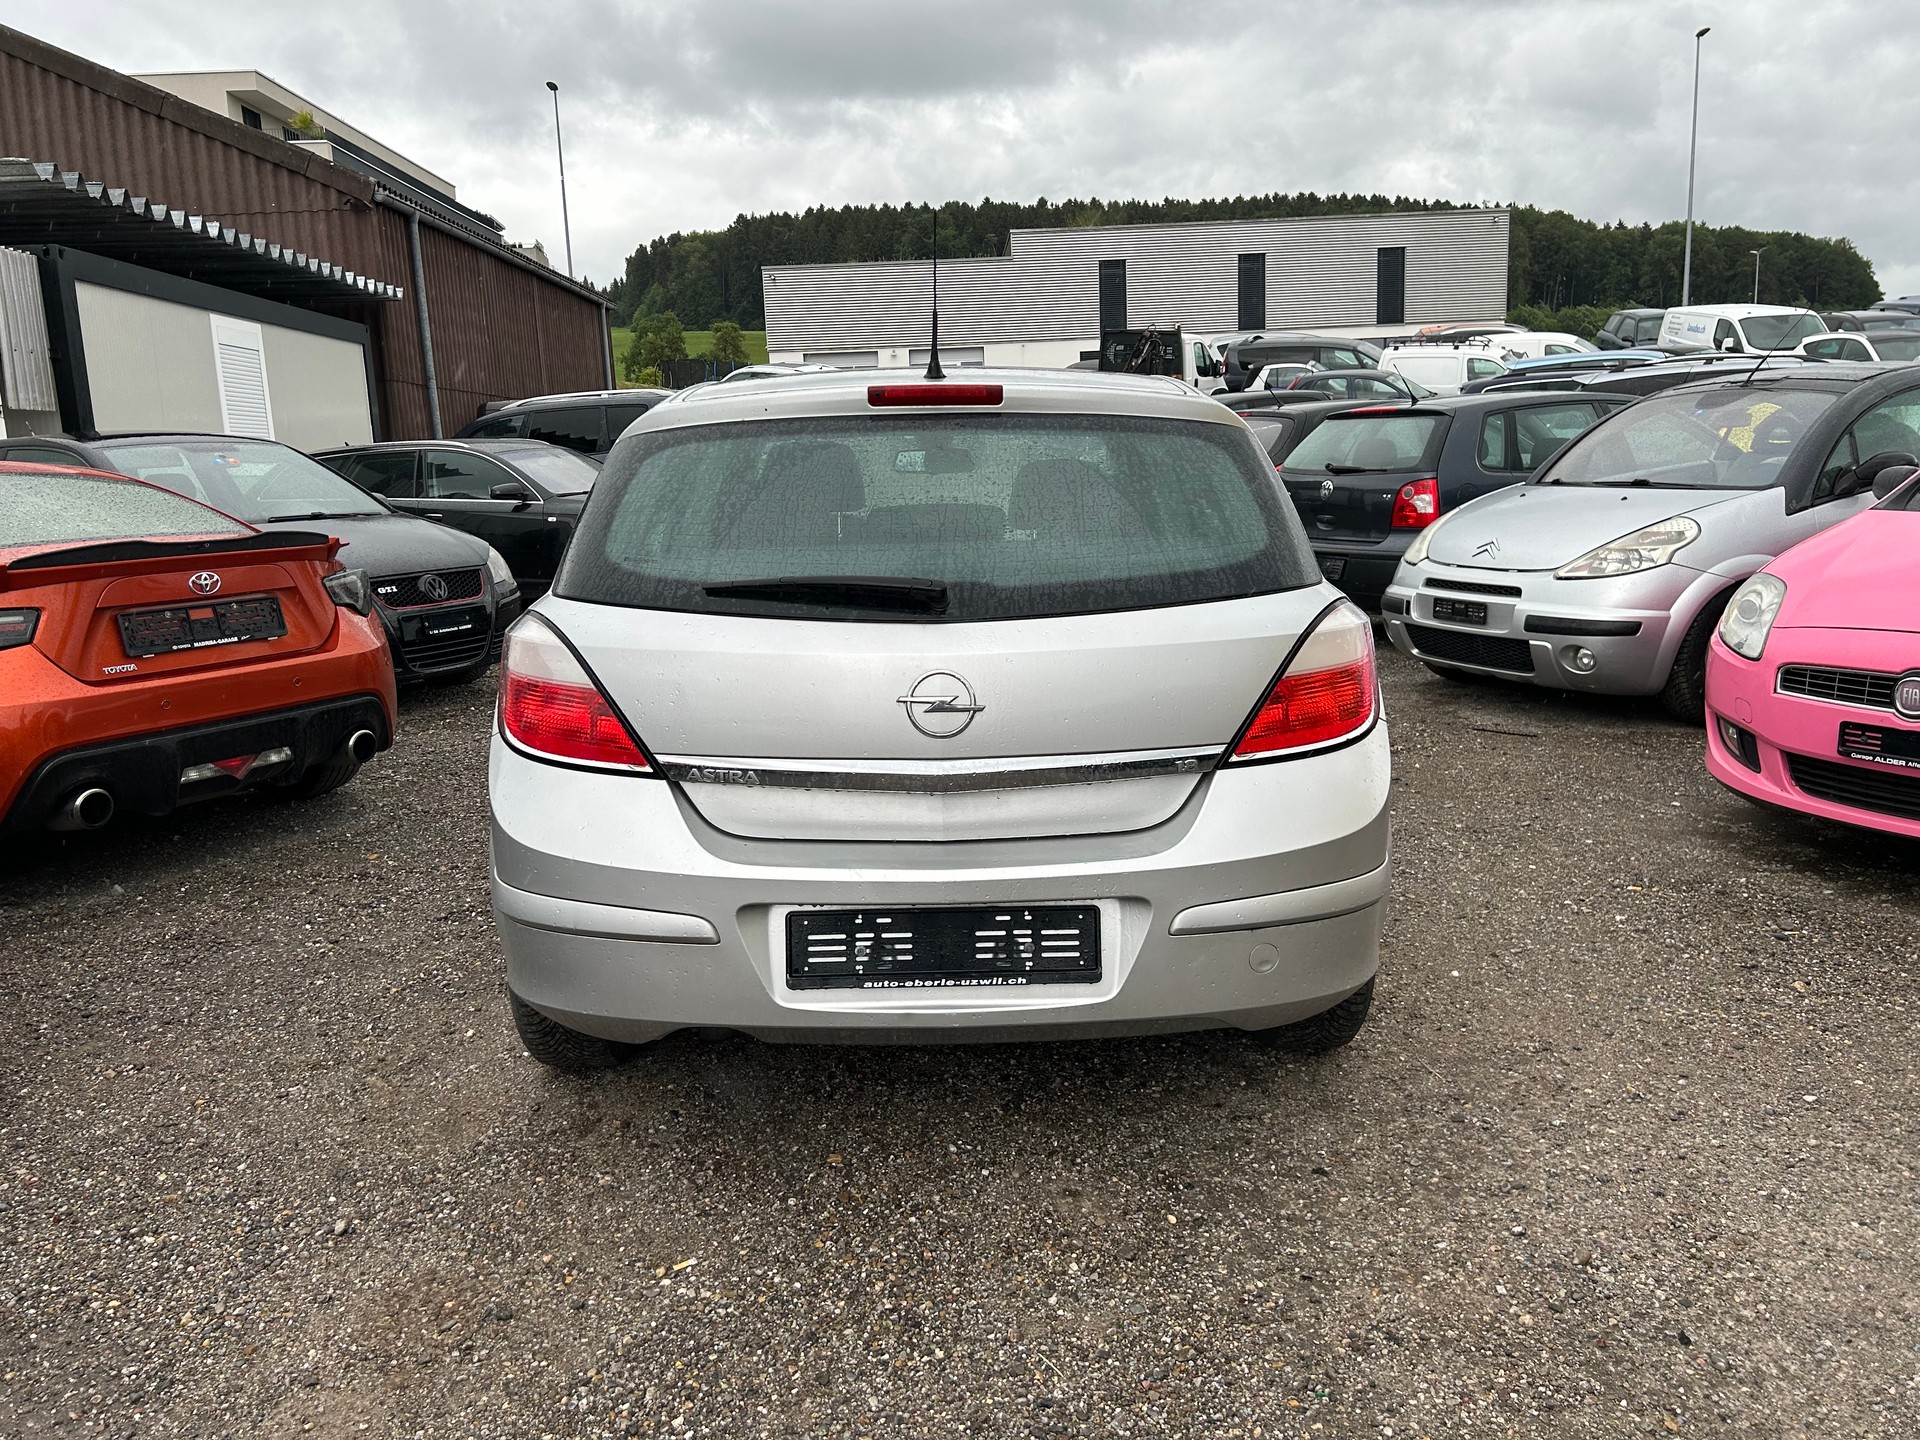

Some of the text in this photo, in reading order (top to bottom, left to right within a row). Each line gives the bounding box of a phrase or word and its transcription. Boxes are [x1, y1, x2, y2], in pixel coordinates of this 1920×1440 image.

[377, 585, 398, 594] GTI
[102, 663, 138, 675] TOYOTA
[1174, 759, 1199, 773] 1.8
[1850, 752, 1873, 761] Garage
[1874, 756, 1906, 767] ALDER
[686, 768, 760, 785] ASTRA
[863, 977, 1027, 988] auto-eberle-uzwil.ch
